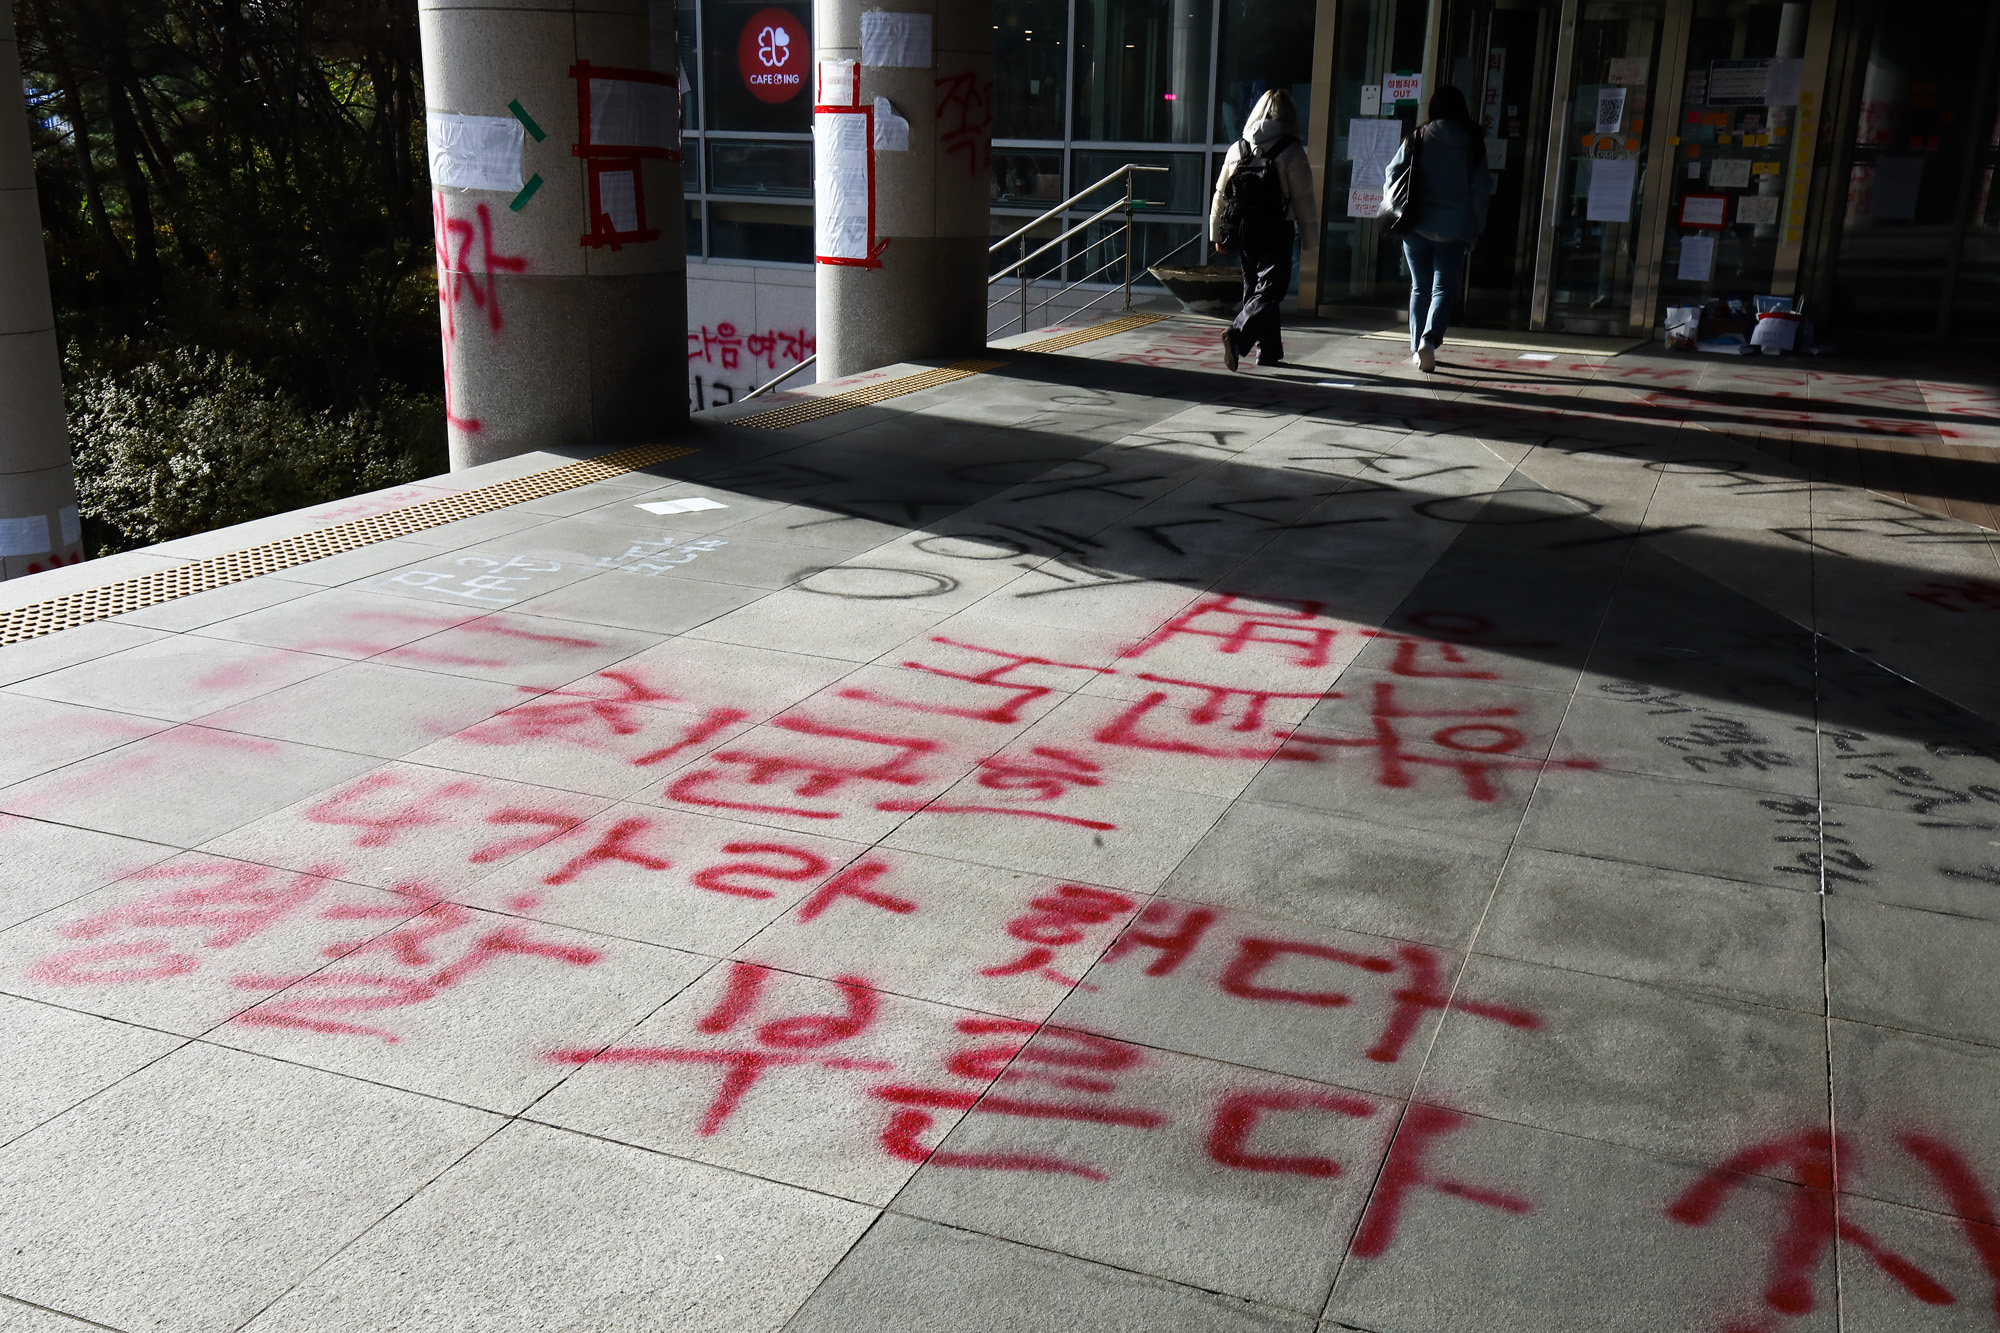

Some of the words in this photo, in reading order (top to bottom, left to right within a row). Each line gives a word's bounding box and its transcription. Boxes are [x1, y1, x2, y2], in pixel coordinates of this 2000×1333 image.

[749, 74, 772, 84] CAFE
[1387, 79, 1419, 88] 성범죄자
[1393, 90, 1411, 98] OUT
[747, 329, 816, 369] 여자
